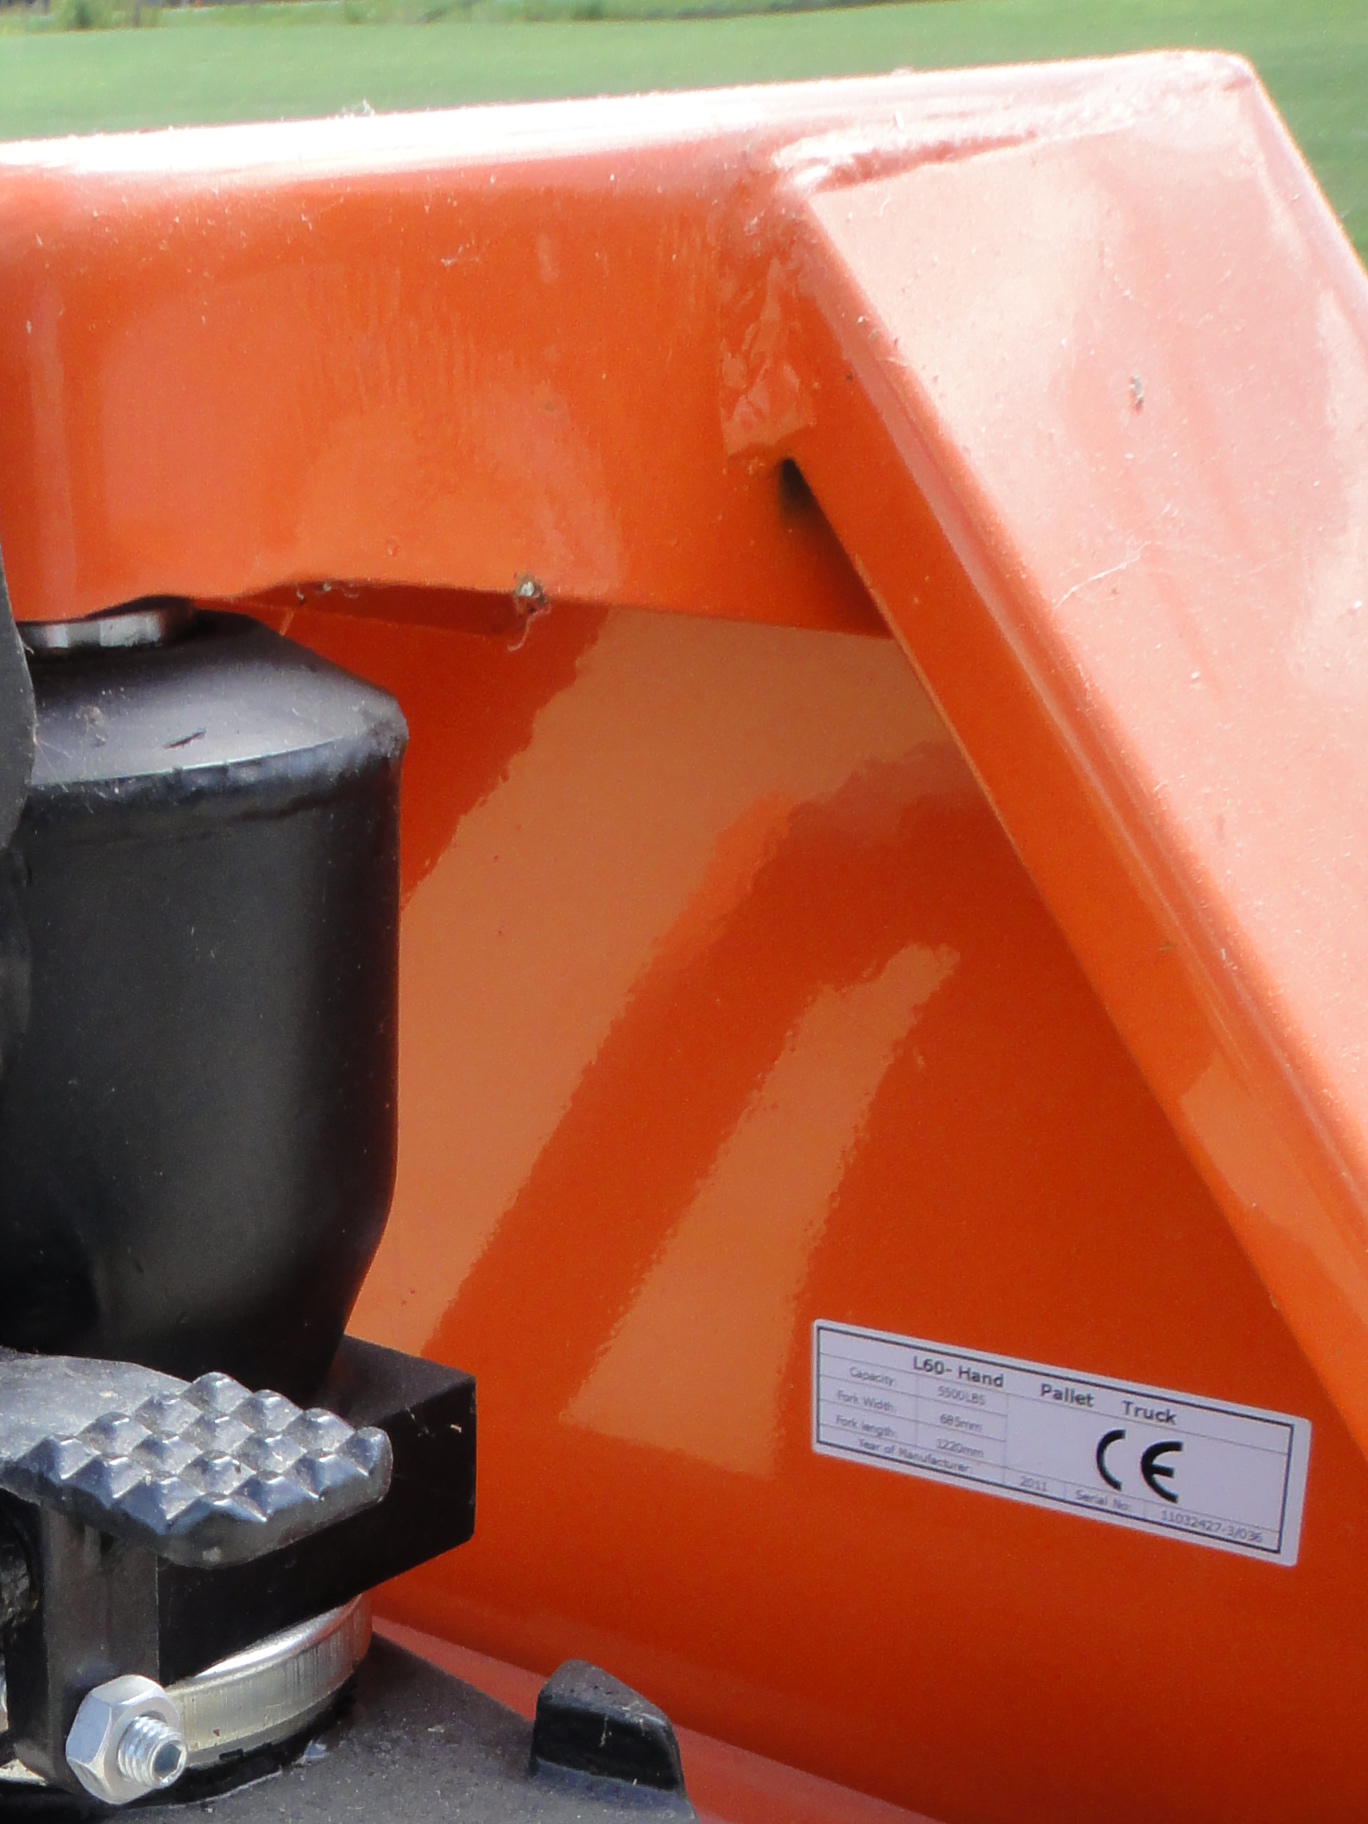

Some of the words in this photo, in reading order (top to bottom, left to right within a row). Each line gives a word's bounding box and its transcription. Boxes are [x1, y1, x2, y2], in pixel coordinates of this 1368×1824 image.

[837, 1390, 859, 1404] Fork
[958, 1365, 1005, 1388] Hand
[1040, 1383, 1095, 1408] Pallet
[1122, 1400, 1178, 1426] Truck
[836, 1414, 858, 1429] Fork
[858, 1438, 881, 1451] Year
[884, 1445, 896, 1454] of
[1096, 1429, 1183, 1504] CE
[1019, 1475, 1047, 1492] 2011
[1075, 1488, 1109, 1506] Serial
